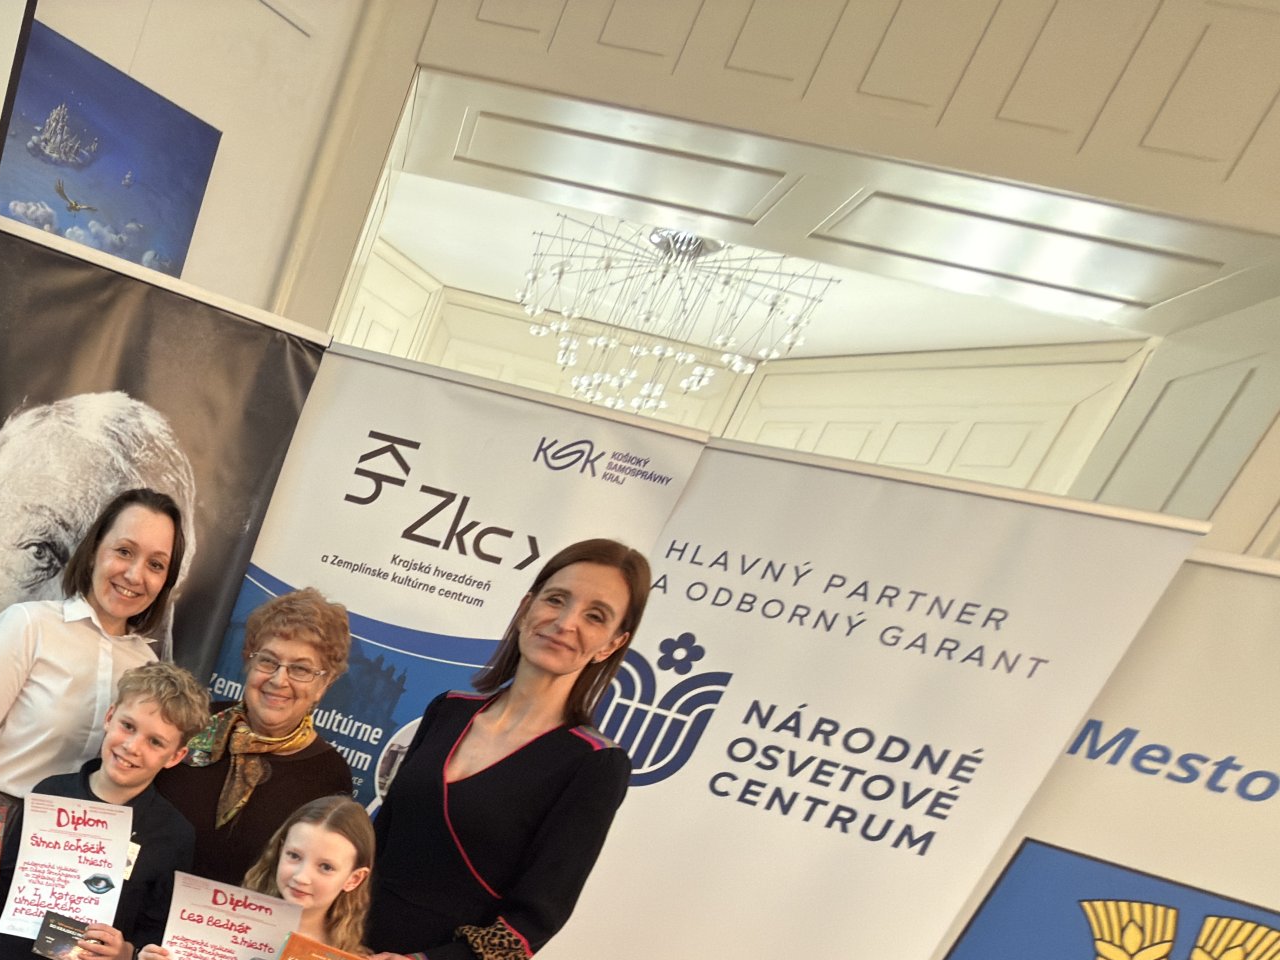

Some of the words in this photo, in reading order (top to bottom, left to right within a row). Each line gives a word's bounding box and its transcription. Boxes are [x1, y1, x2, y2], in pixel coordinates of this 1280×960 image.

[532, 436, 606, 478] KSK
[601, 471, 626, 485] KRAJ
[605, 461, 673, 486] SAMOSPRÁVNY
[321, 553, 329, 563] a
[330, 555, 389, 581] Zemplínske
[391, 573, 436, 594] kultúrne
[438, 587, 484, 608] centrum
[390, 554, 431, 575] Krajská
[433, 565, 492, 592] hvezdáreň
[664, 539, 814, 588] HLAVNÝ
[822, 573, 1010, 631] PARTNER
[651, 573, 669, 595] A
[686, 581, 869, 638] ODBORNÝ
[879, 624, 1050, 681] GARANT
[741, 699, 985, 784] NÁRODNÉ
[1066, 717, 1280, 804] Mesto
[725, 736, 960, 821] OSVETOVÉ
[56, 808, 108, 831] Diplom
[708, 773, 936, 857] CENTRUM
[12, 906, 45, 918] predn
[180, 908, 204, 924] Lea
[207, 916, 252, 934] Bednár
[212, 888, 273, 916] Diplom
